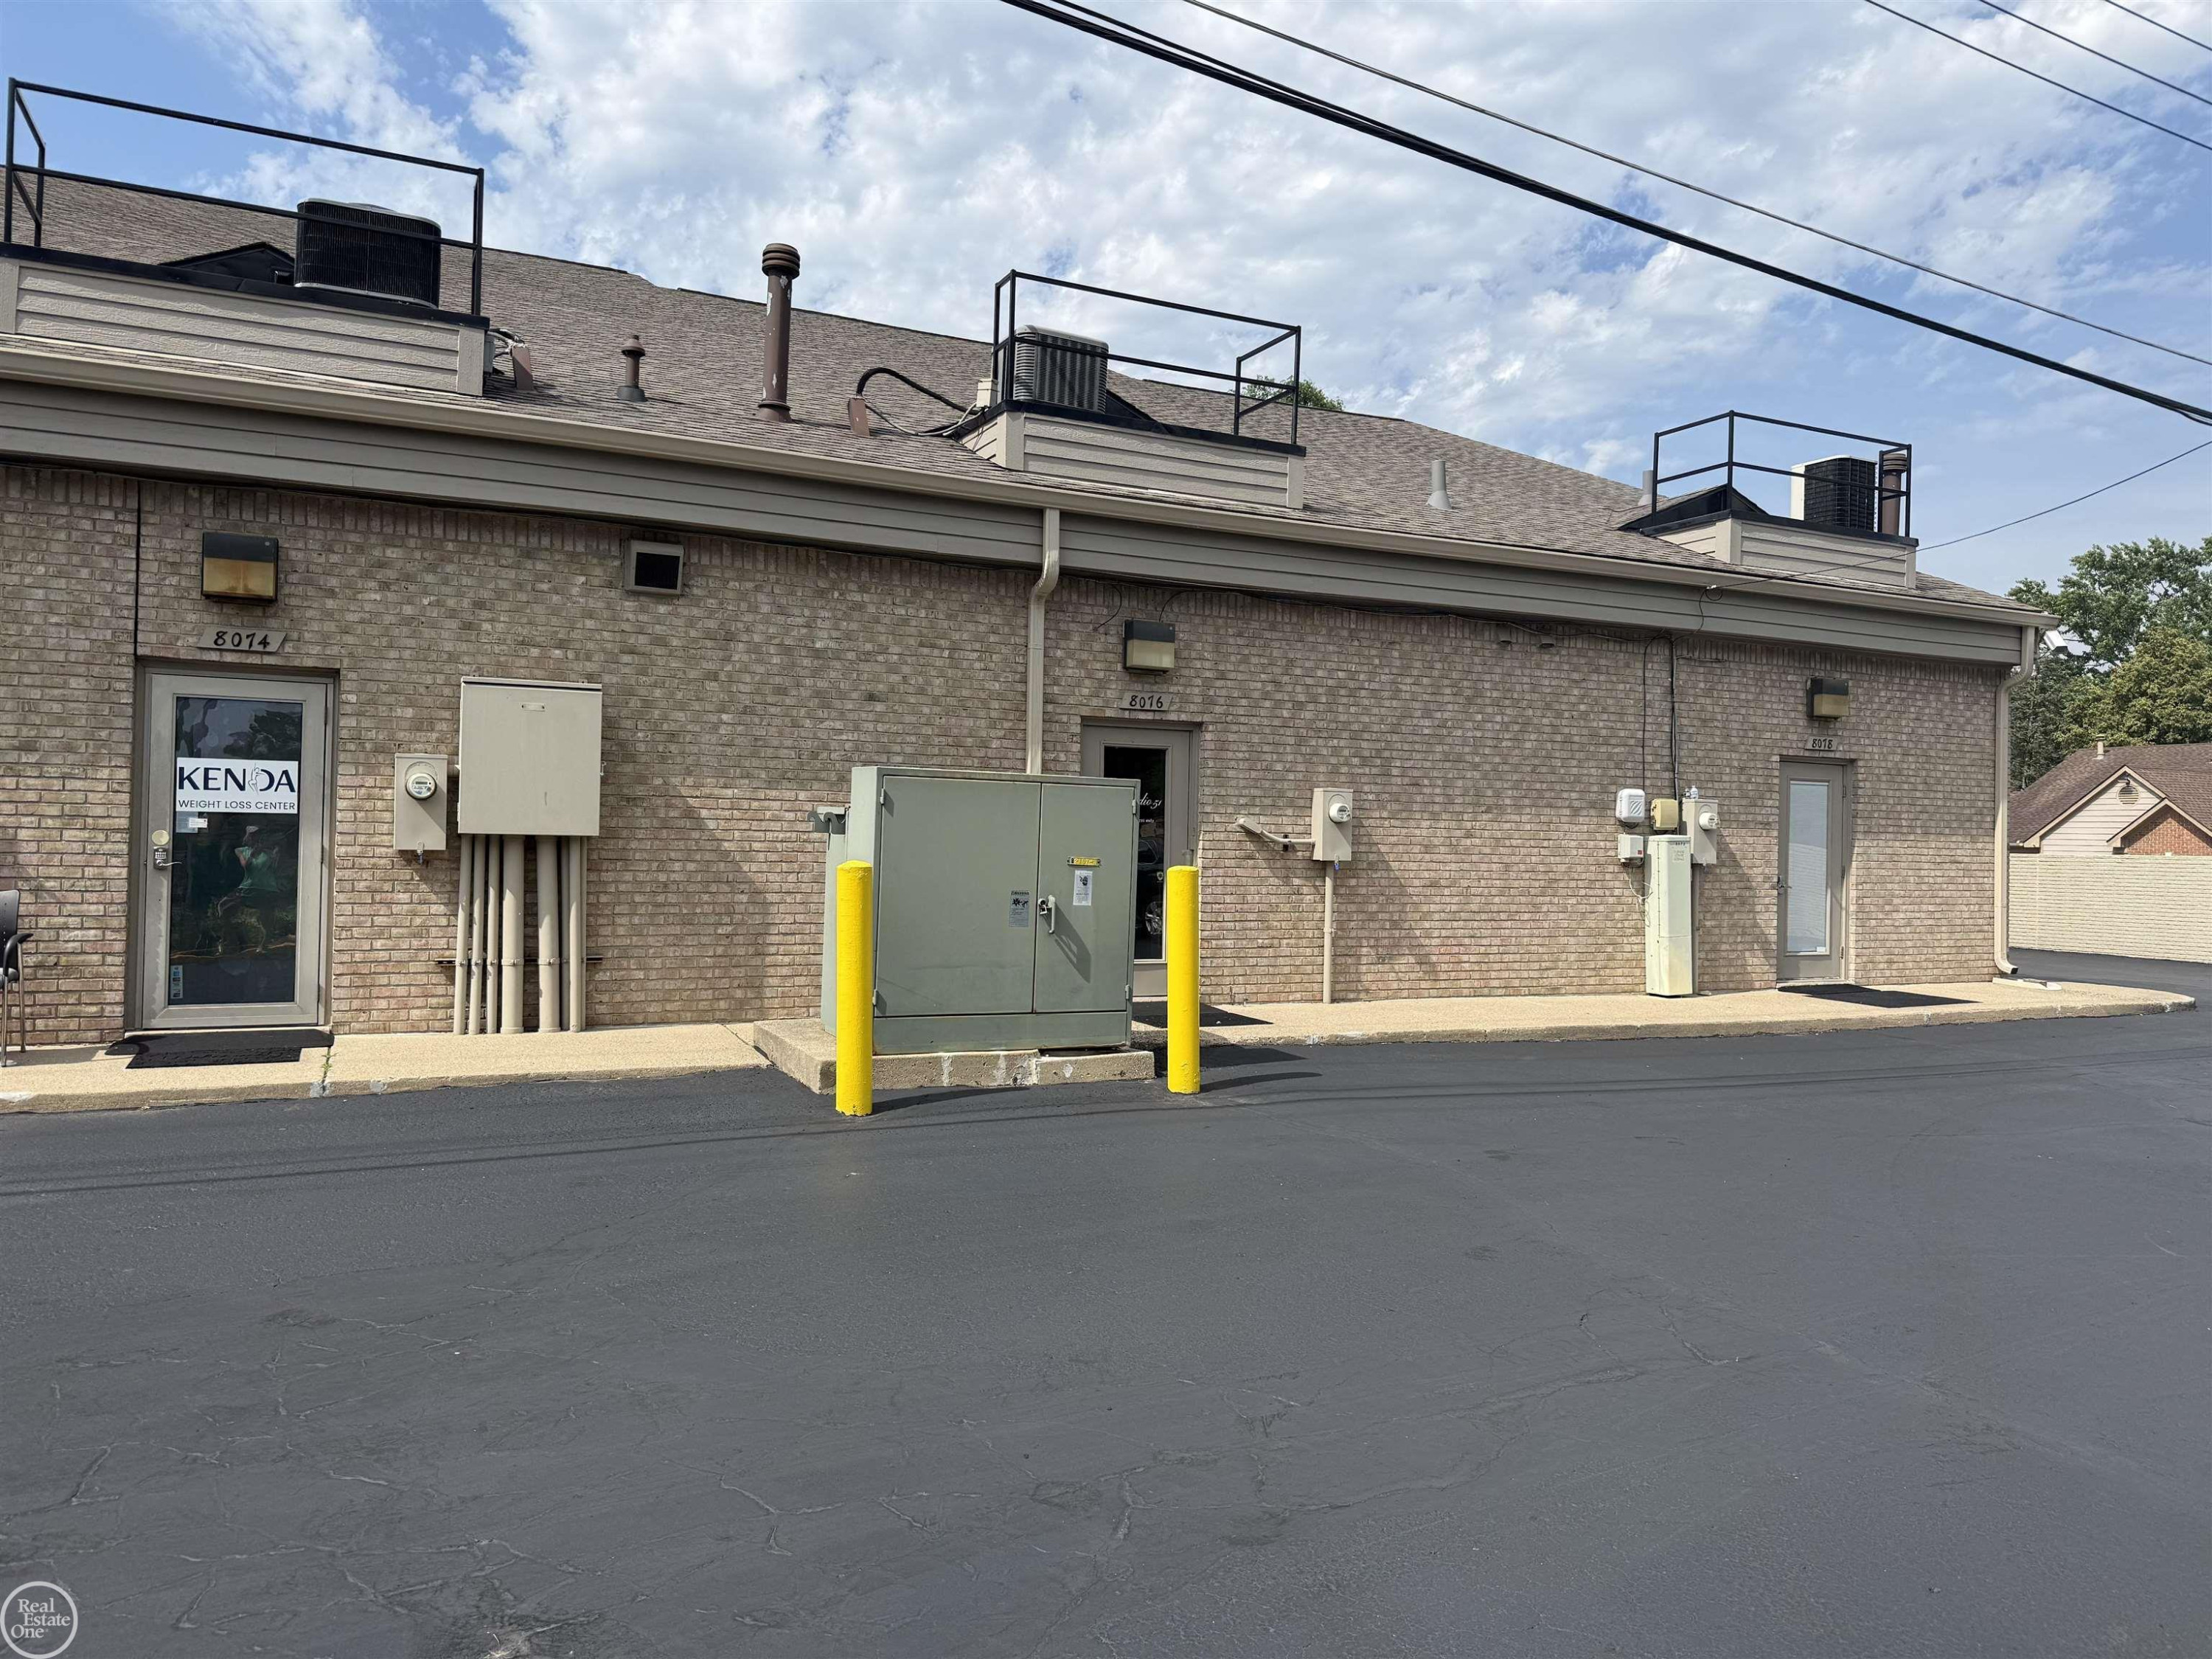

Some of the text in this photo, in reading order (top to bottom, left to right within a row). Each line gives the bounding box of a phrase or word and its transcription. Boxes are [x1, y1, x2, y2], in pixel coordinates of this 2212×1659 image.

[213, 630, 271, 650] 8074
[1129, 695, 1164, 709] 8076
[1812, 738, 1833, 749] 8078
[178, 766, 296, 793] KENDA
[178, 799, 296, 810] WEIGHT LOSS CENTER
[1140, 793, 1163, 810] dio 51
